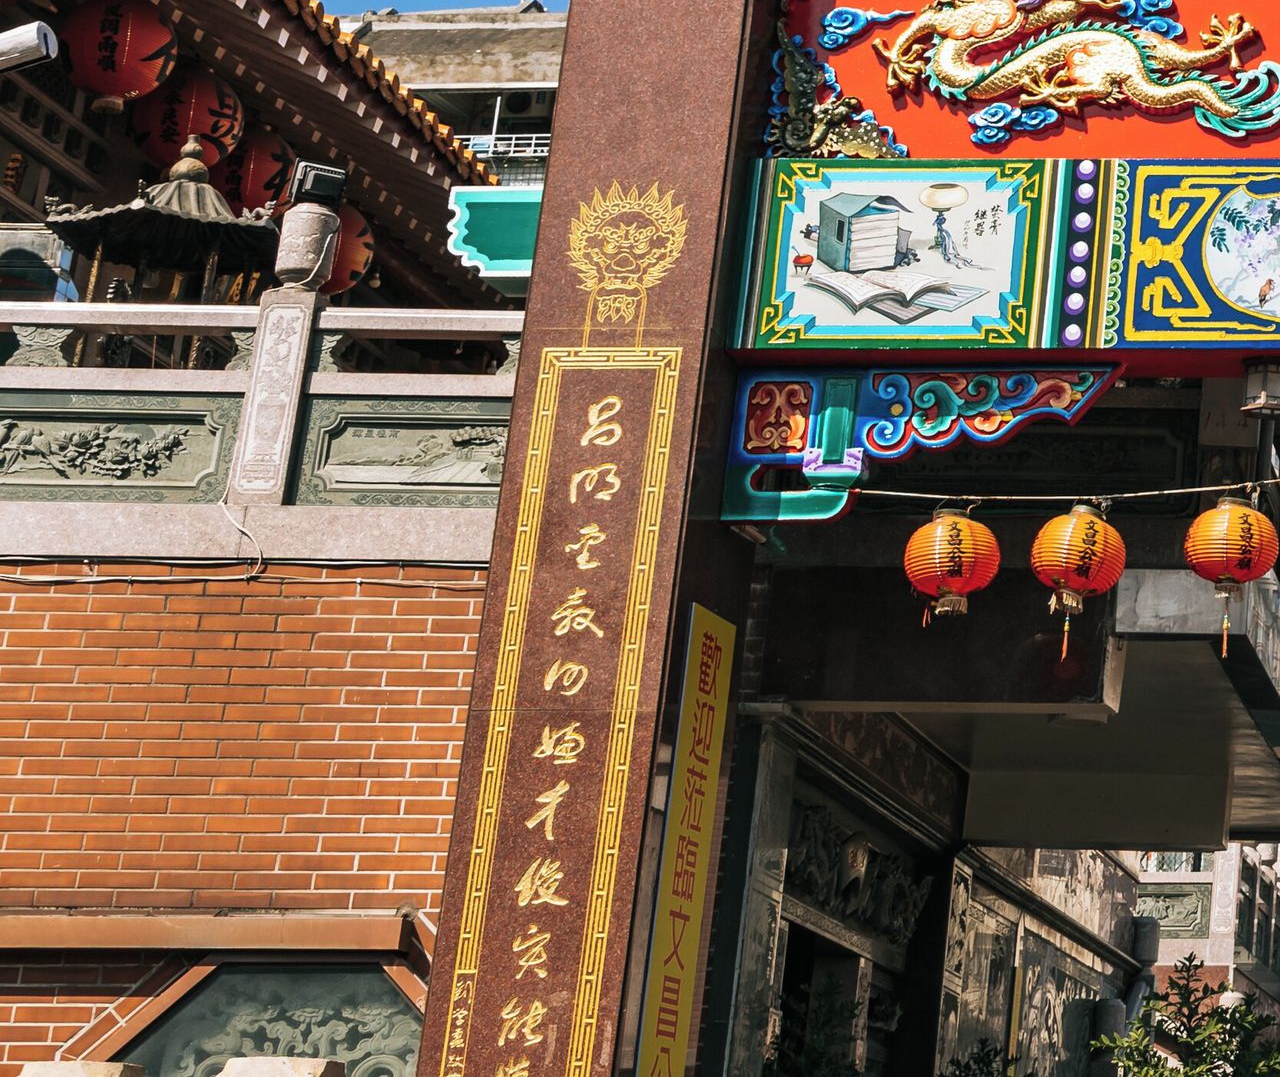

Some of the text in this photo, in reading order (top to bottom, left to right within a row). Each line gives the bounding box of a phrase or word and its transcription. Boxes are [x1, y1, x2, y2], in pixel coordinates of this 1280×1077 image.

[939, 520, 967, 578] 文昌公廟
[1072, 519, 1100, 579] 文昌公廟
[1233, 512, 1255, 570] 文昌公廟
